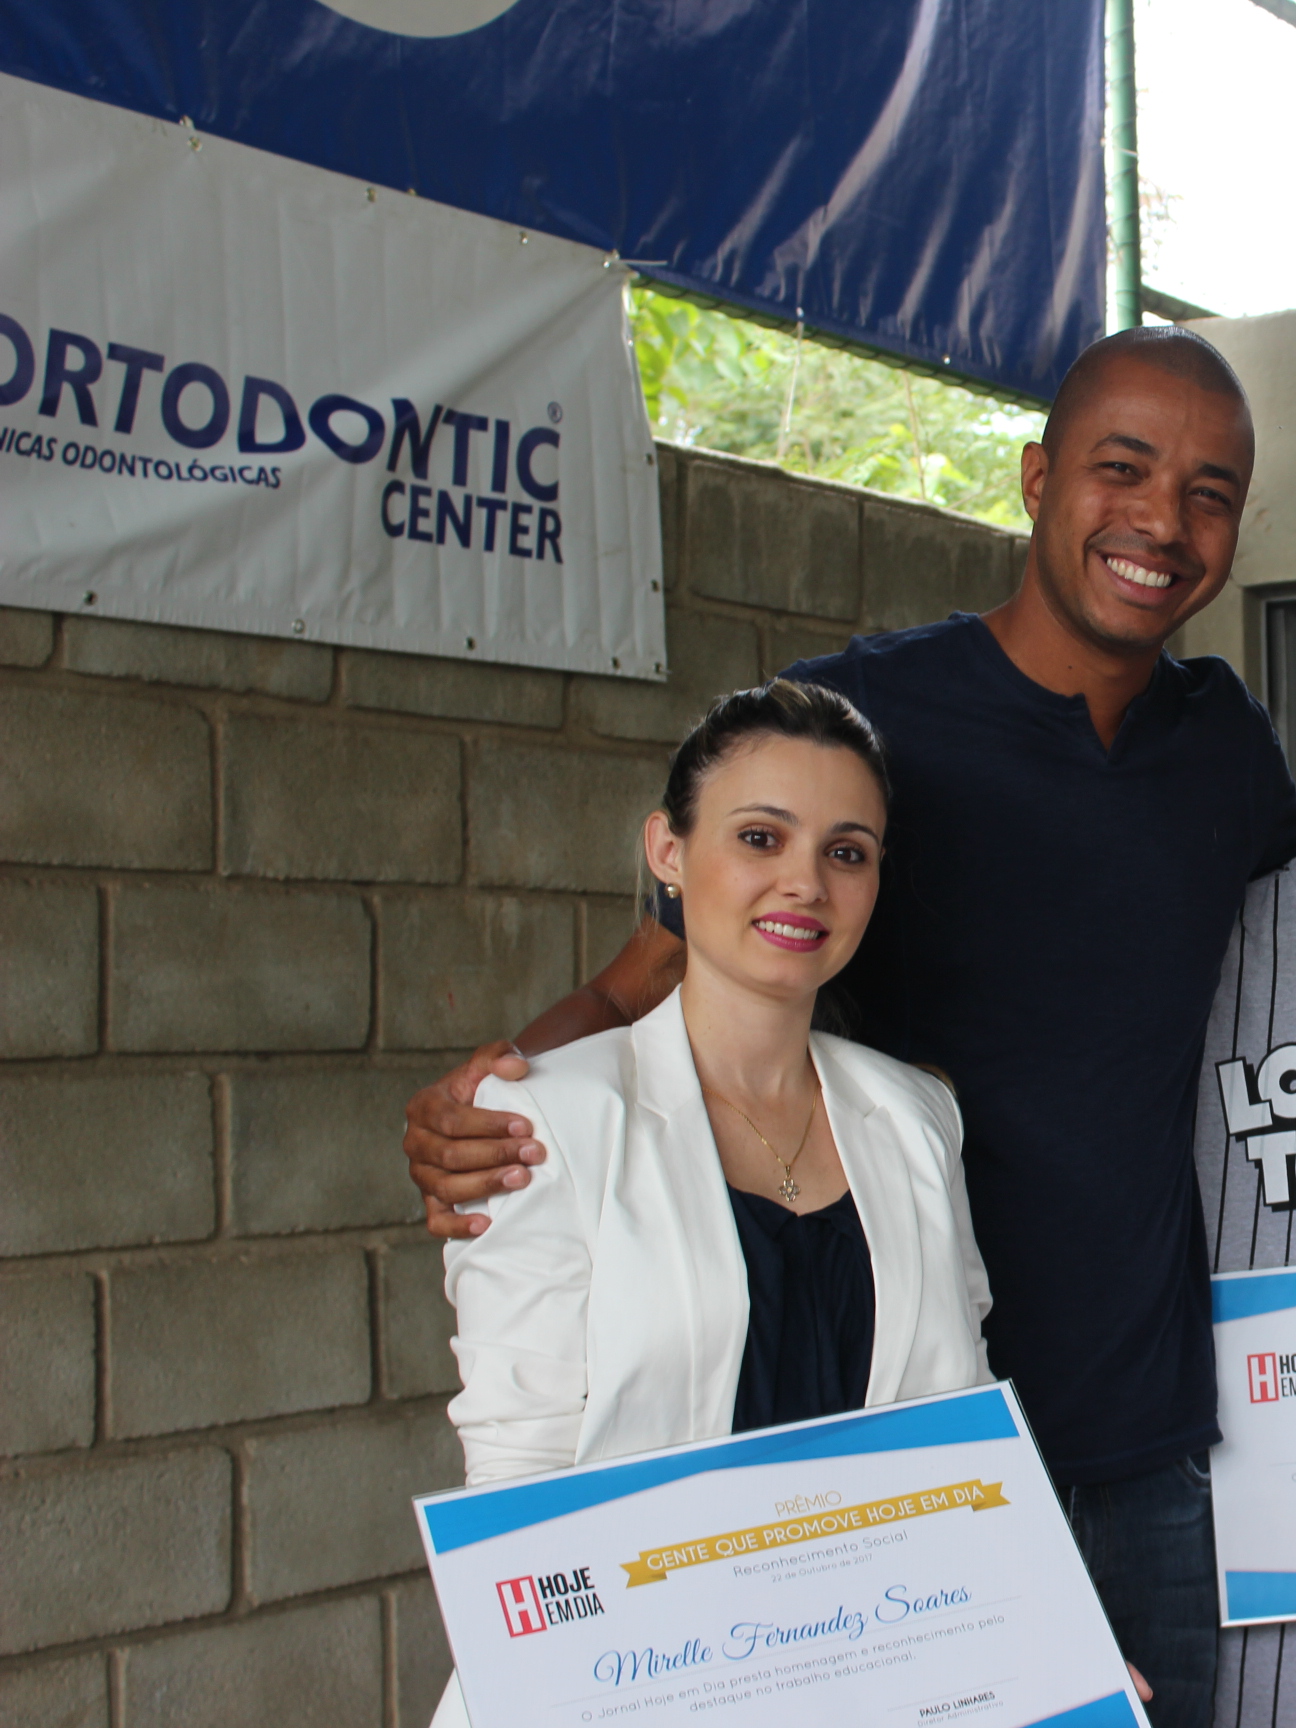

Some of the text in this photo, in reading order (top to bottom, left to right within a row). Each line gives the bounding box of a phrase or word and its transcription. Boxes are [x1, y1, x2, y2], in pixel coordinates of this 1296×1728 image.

[61, 442, 282, 489] ODONTOLÓGICAS
[380, 480, 564, 565] CENTER
[775, 1490, 842, 1518] PRÊMIO
[646, 1485, 985, 1571] GENTE QUE PROMOVE HOJE EM DIA
[733, 1529, 909, 1578] Reconhecimento Social
[853, 1554, 873, 1567] 2017
[538, 1566, 595, 1600] HOJE
[593, 1584, 972, 1686] Mirelle Fernandez Soares
[581, 1710, 593, 1722] O
[598, 1699, 642, 1719] Jornal
[644, 1692, 675, 1709] Hoje
[678, 1686, 700, 1699] em
[703, 1679, 726, 1694] Dia
[729, 1668, 772, 1690] presta
[774, 1650, 857, 1677] homenagem
[873, 1620, 975, 1653] reconhecimento
[978, 1613, 1005, 1631] pelo
[689, 1689, 752, 1713] destaque
[756, 1685, 772, 1697] no
[776, 1670, 831, 1691] trabalho
[919, 1690, 996, 1718] PAULO LINHARES
